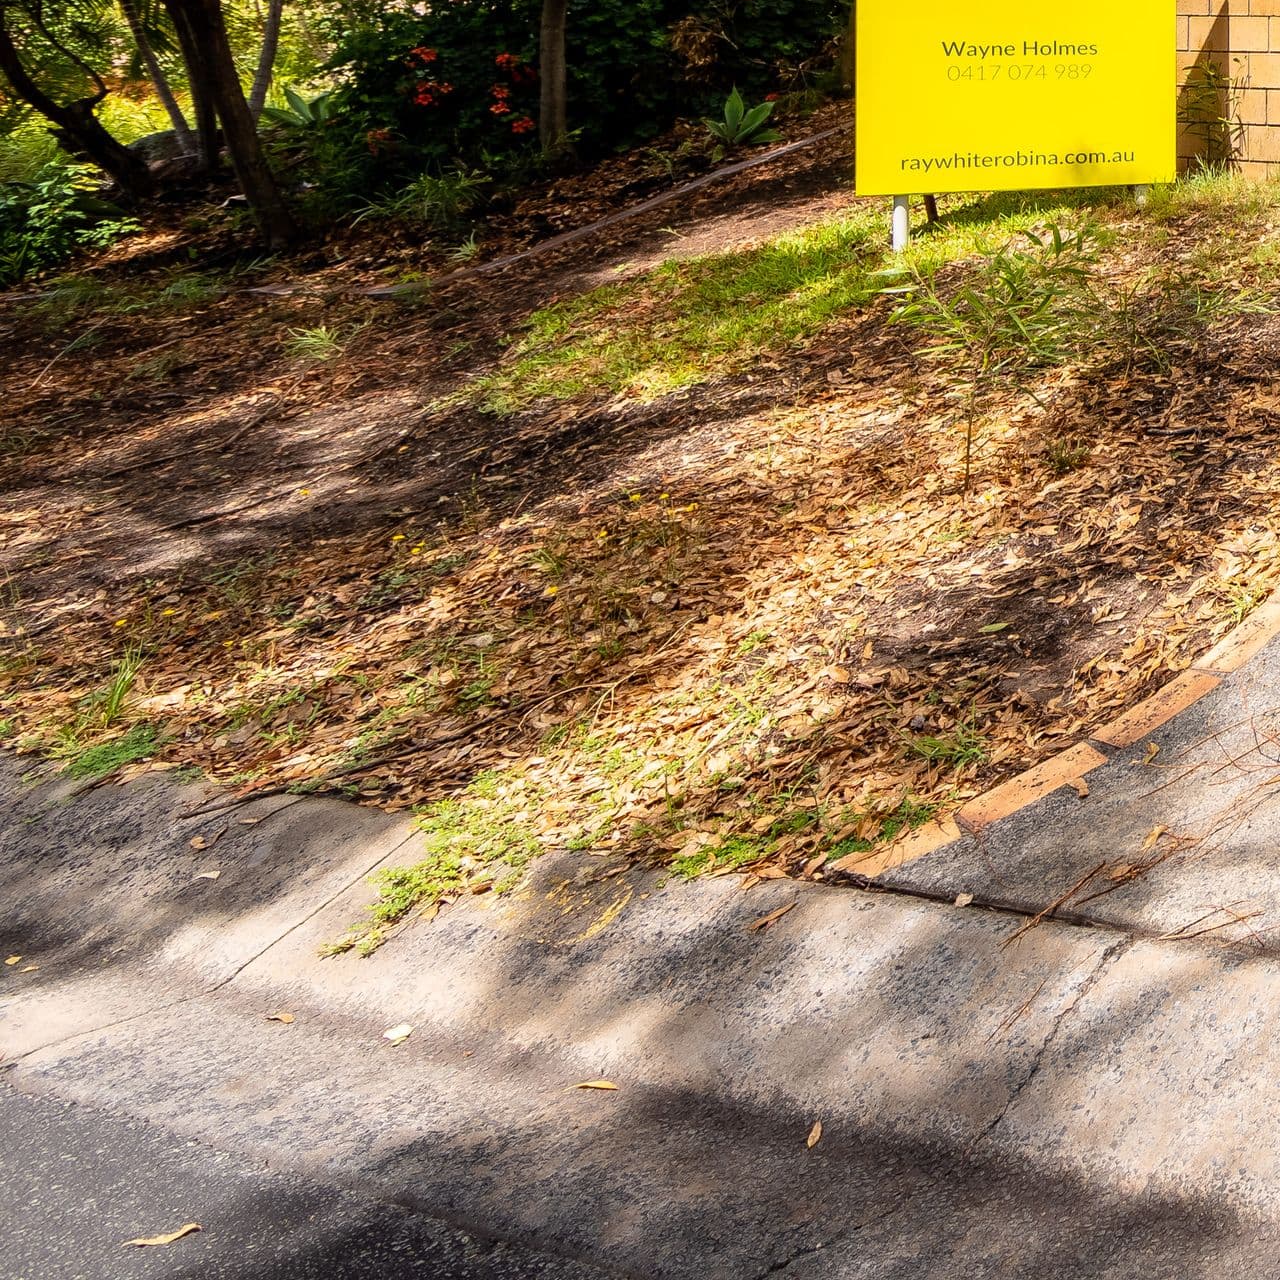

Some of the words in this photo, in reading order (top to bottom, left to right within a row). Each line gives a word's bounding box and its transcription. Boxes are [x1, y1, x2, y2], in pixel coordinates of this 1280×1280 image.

[941, 40, 1016, 59] Wayne
[1022, 40, 1098, 57] Holmes
[946, 65, 1001, 81] 0417
[1007, 64, 1048, 80] 074
[1054, 63, 1093, 79] 989
[900, 150, 1135, 173] raywhiterobina.com.au
